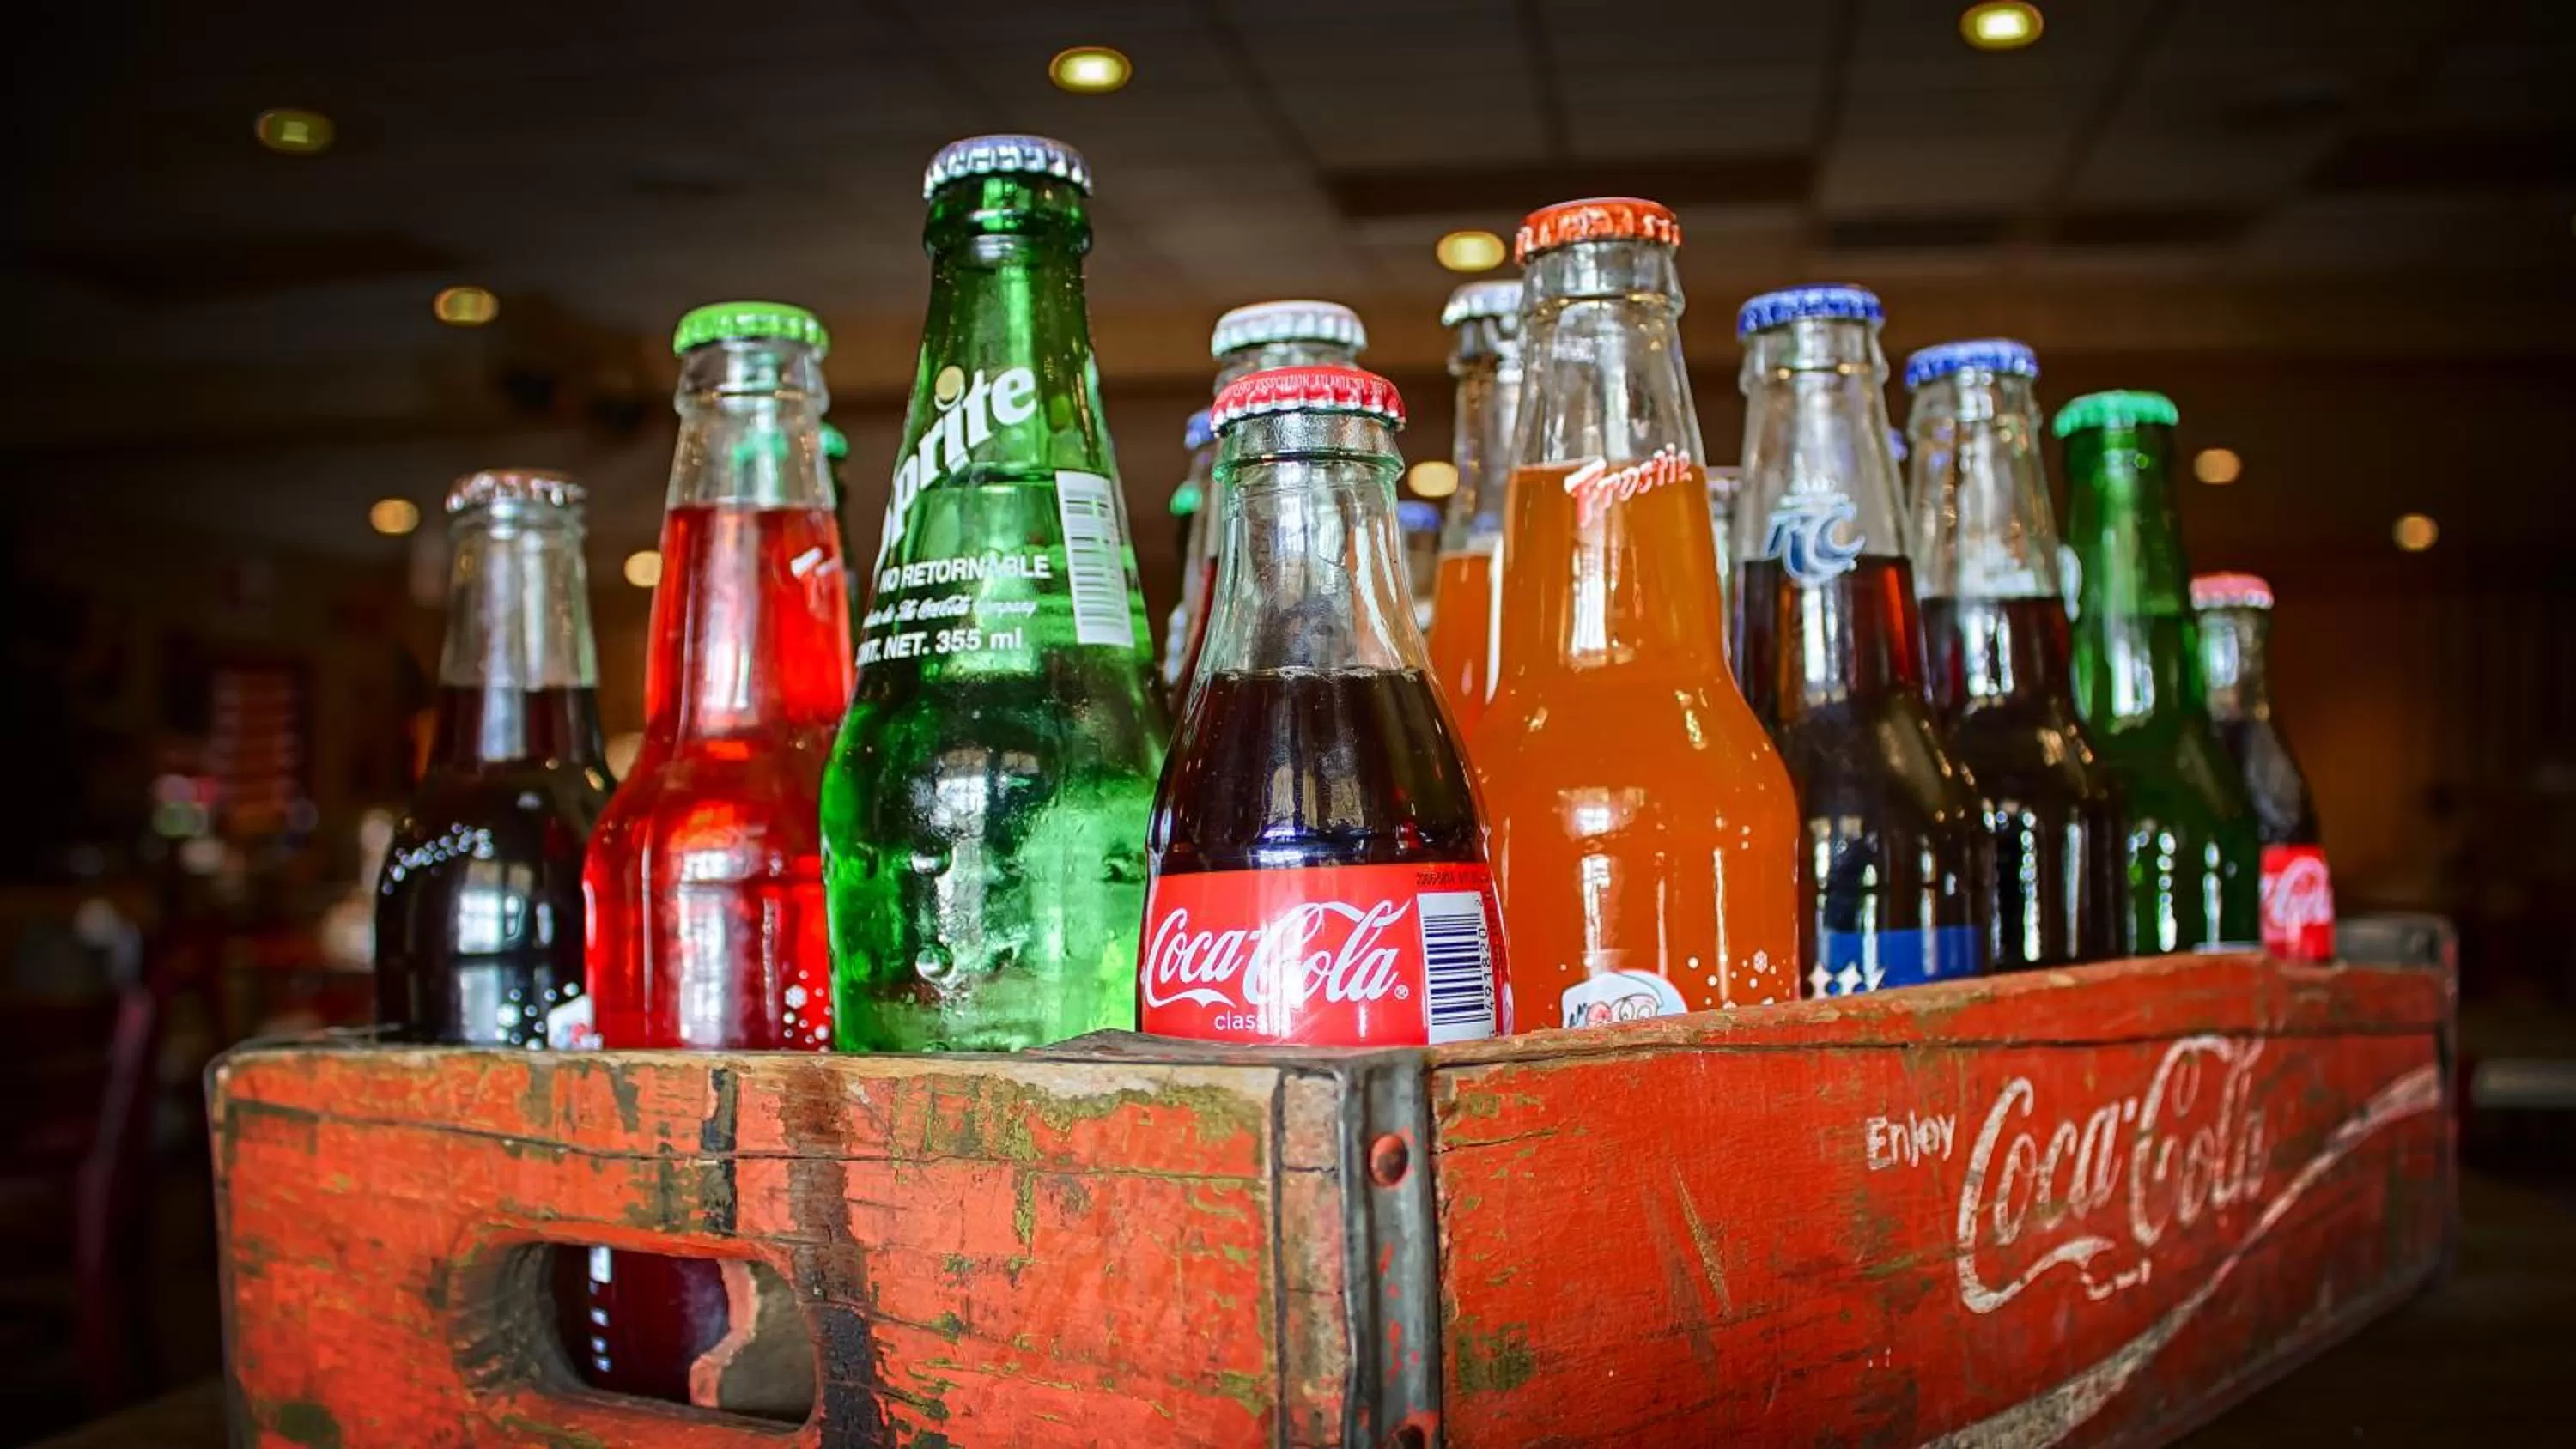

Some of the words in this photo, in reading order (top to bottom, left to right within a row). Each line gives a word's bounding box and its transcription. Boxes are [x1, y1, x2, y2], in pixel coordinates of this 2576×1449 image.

[872, 365, 1037, 573] prite
[879, 567, 901, 593] NO
[901, 554, 1053, 589] RETORNABLE
[883, 631, 932, 661] NET.
[934, 627, 982, 655] 355
[989, 627, 1023, 650] ml
[1145, 899, 1411, 1009] Coca-Cola
[1866, 1108, 1956, 1171] Enjoy
[1957, 1023, 2272, 1313] Coca-Cola
